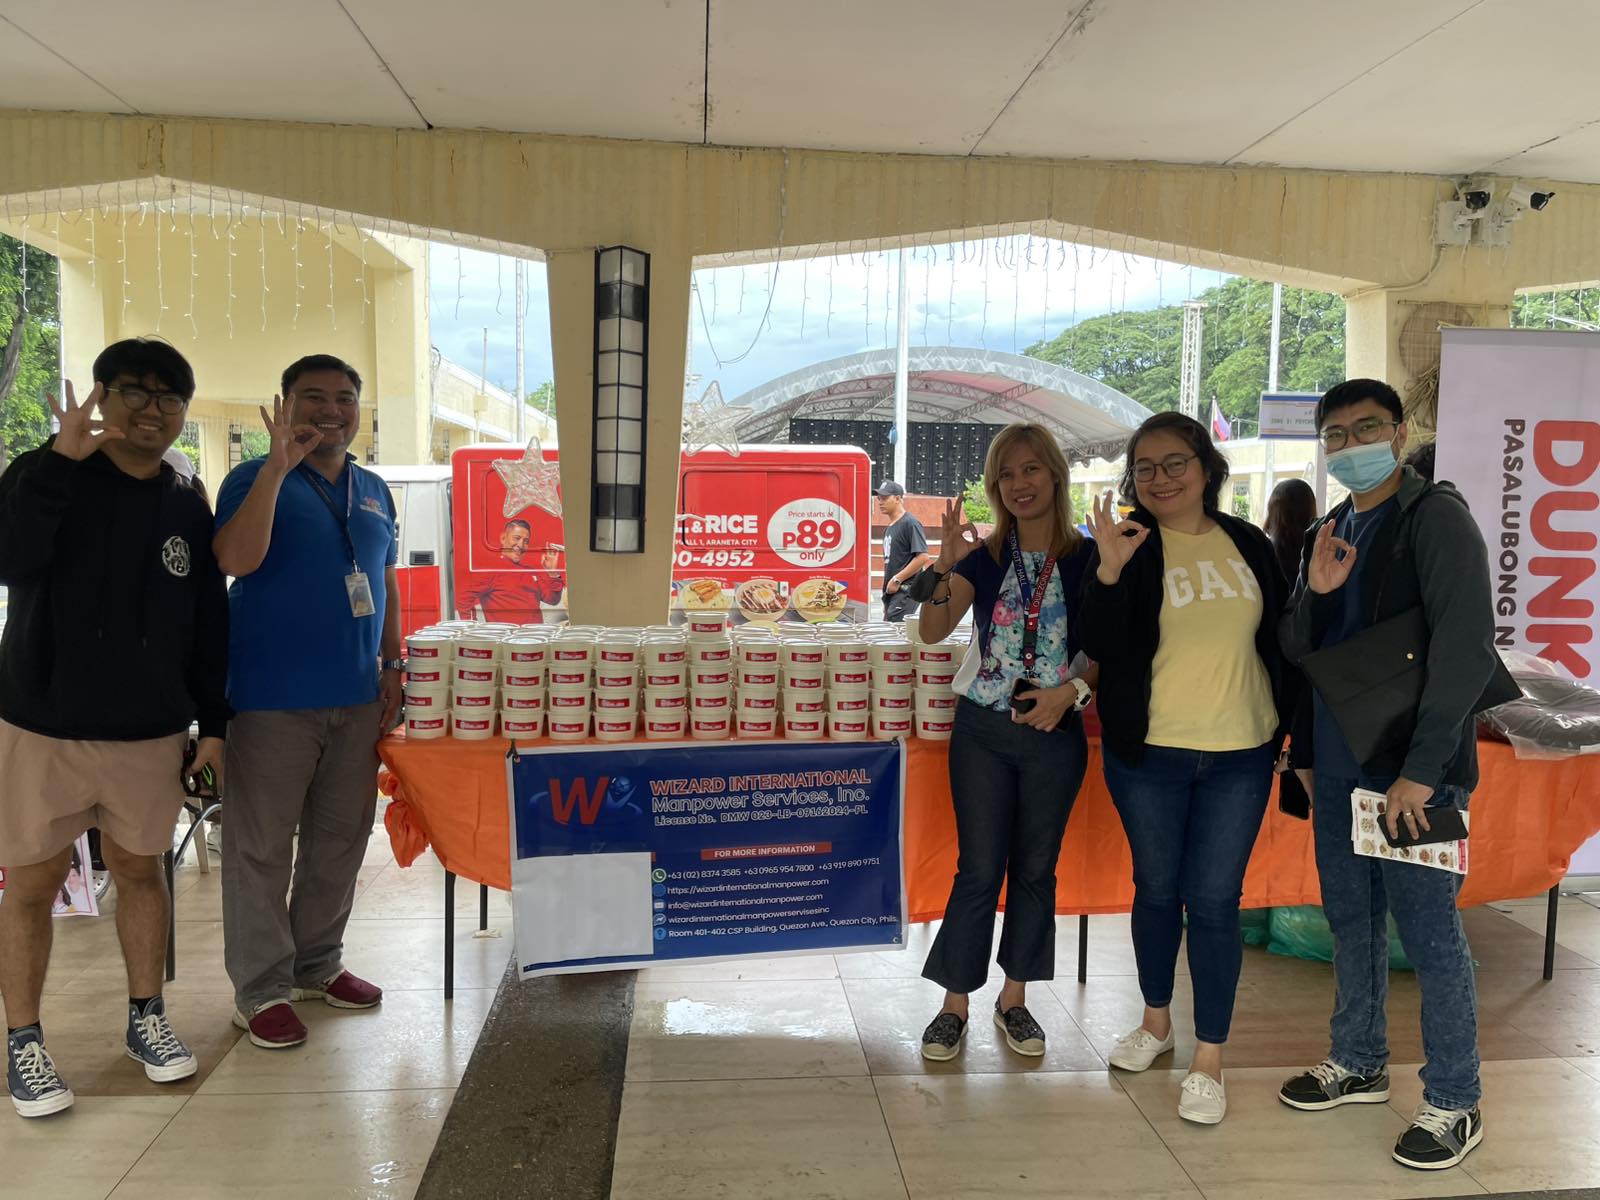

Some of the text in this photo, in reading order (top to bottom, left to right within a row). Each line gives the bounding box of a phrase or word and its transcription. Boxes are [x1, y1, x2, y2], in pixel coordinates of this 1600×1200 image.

[691, 521, 703, 533] &
[705, 514, 758, 534] RICE
[1497, 419, 1526, 617] PASALUBONG
[800, 549, 825, 562] only
[1016, 568, 1027, 586] HALL
[1033, 573, 1049, 608] QUEZON
[650, 768, 872, 796] WIZARD INTERNATIONAL
[548, 776, 610, 826] W
[651, 786, 870, 815] Manpower Services, Inc.
[654, 815, 697, 826] License
[698, 813, 716, 824] No.
[720, 811, 750, 823] DMW
[714, 845, 815, 858] FOR MORE INFORMATION
[668, 871, 682, 879] +63
[683, 871, 700, 880] (02)
[701, 870, 720, 878] 8374
[744, 867, 758, 876] +63
[759, 866, 779, 875] 0965
[780, 865, 794, 873] 954
[795, 864, 814, 872] 7800
[818, 862, 833, 870] +63
[834, 860, 847, 869] 919
[848, 859, 862, 868] 890
[863, 857, 880, 866] 9751
[668, 930, 693, 938] Room
[694, 928, 726, 937] 401-402
[727, 927, 743, 935] CSP
[744, 925, 777, 934] Building,
[779, 922, 809, 931] Quezon
[830, 918, 860, 927] Quezon
[861, 916, 878, 925] City,
